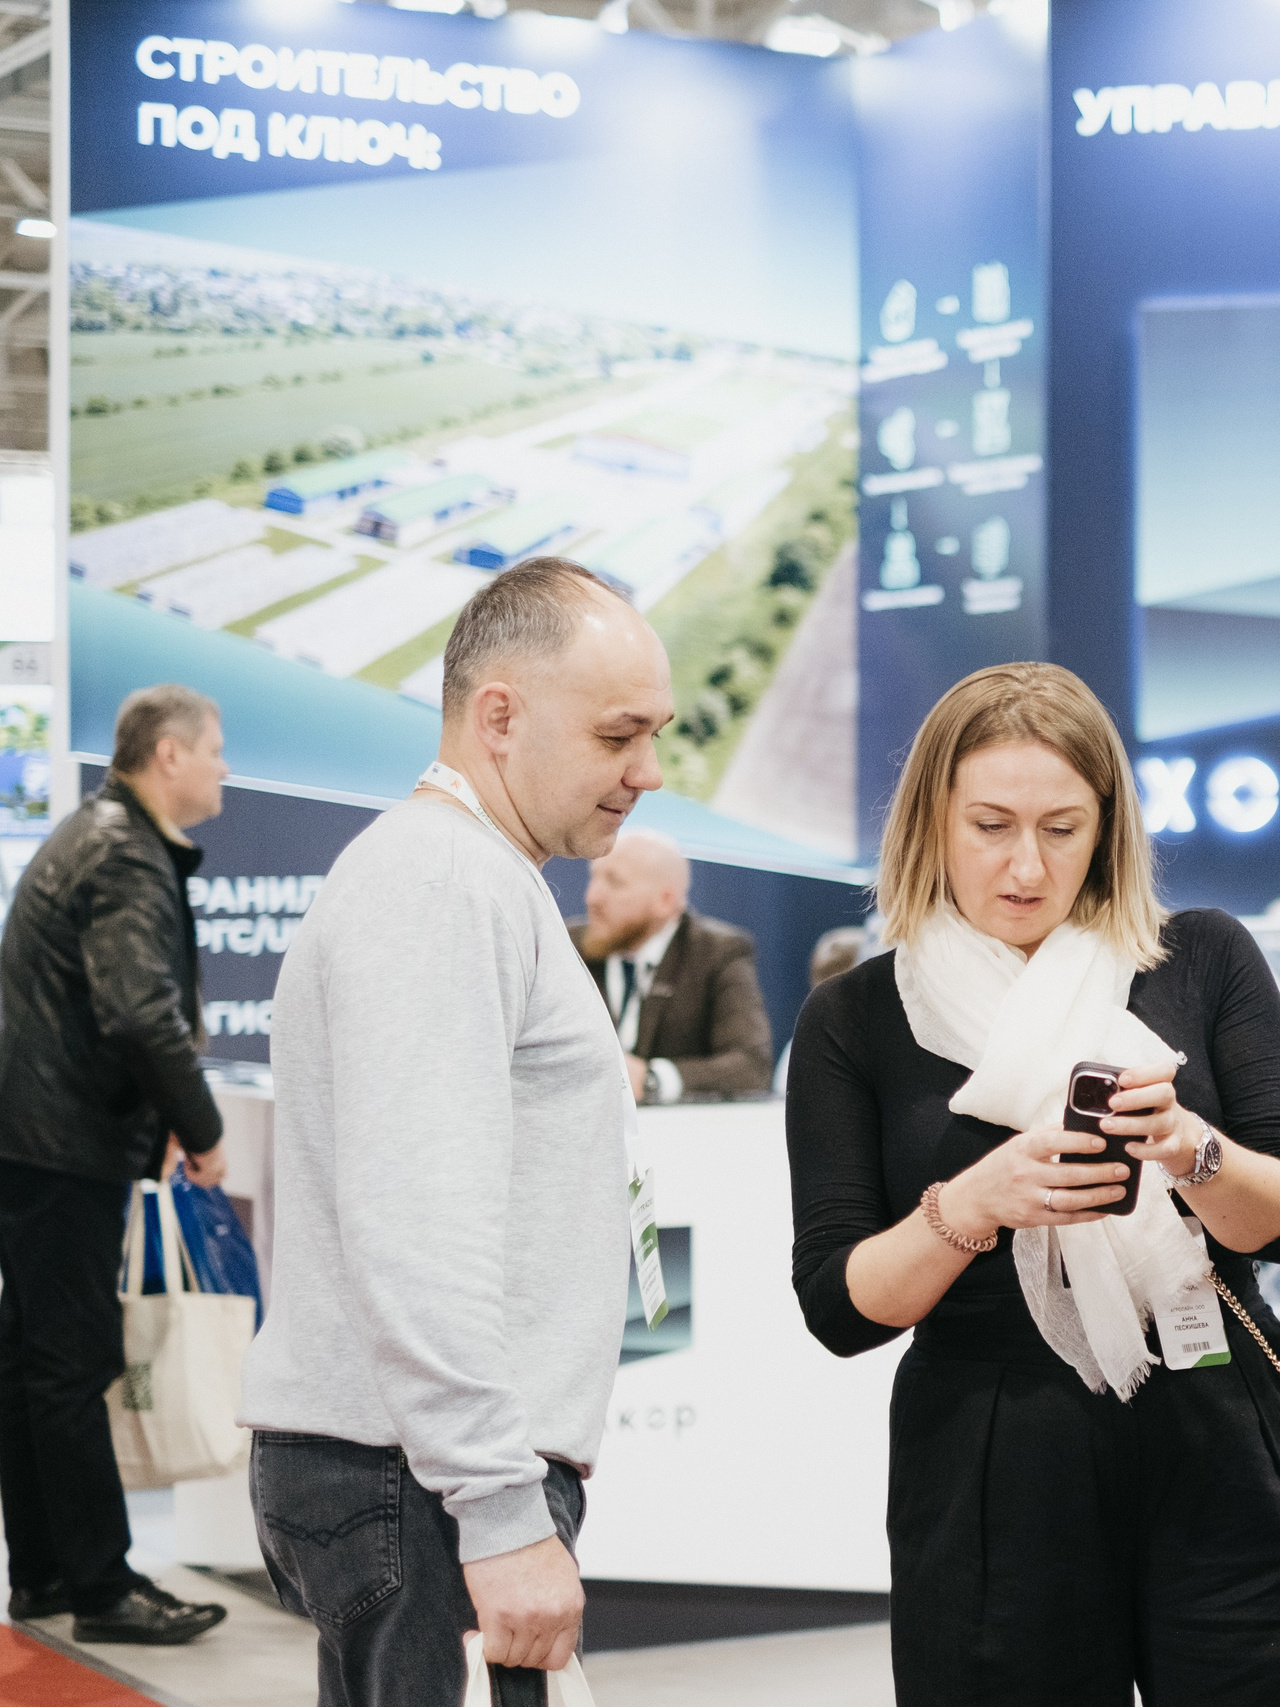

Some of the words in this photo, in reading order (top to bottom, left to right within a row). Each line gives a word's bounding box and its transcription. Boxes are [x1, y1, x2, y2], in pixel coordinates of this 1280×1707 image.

[135, 35, 580, 119] СТРОИТЕЛЬСТВО
[138, 102, 260, 162] ПОД
[267, 112, 442, 170] КЛЮЧ:
[1181, 1315, 1198, 1323] АННА
